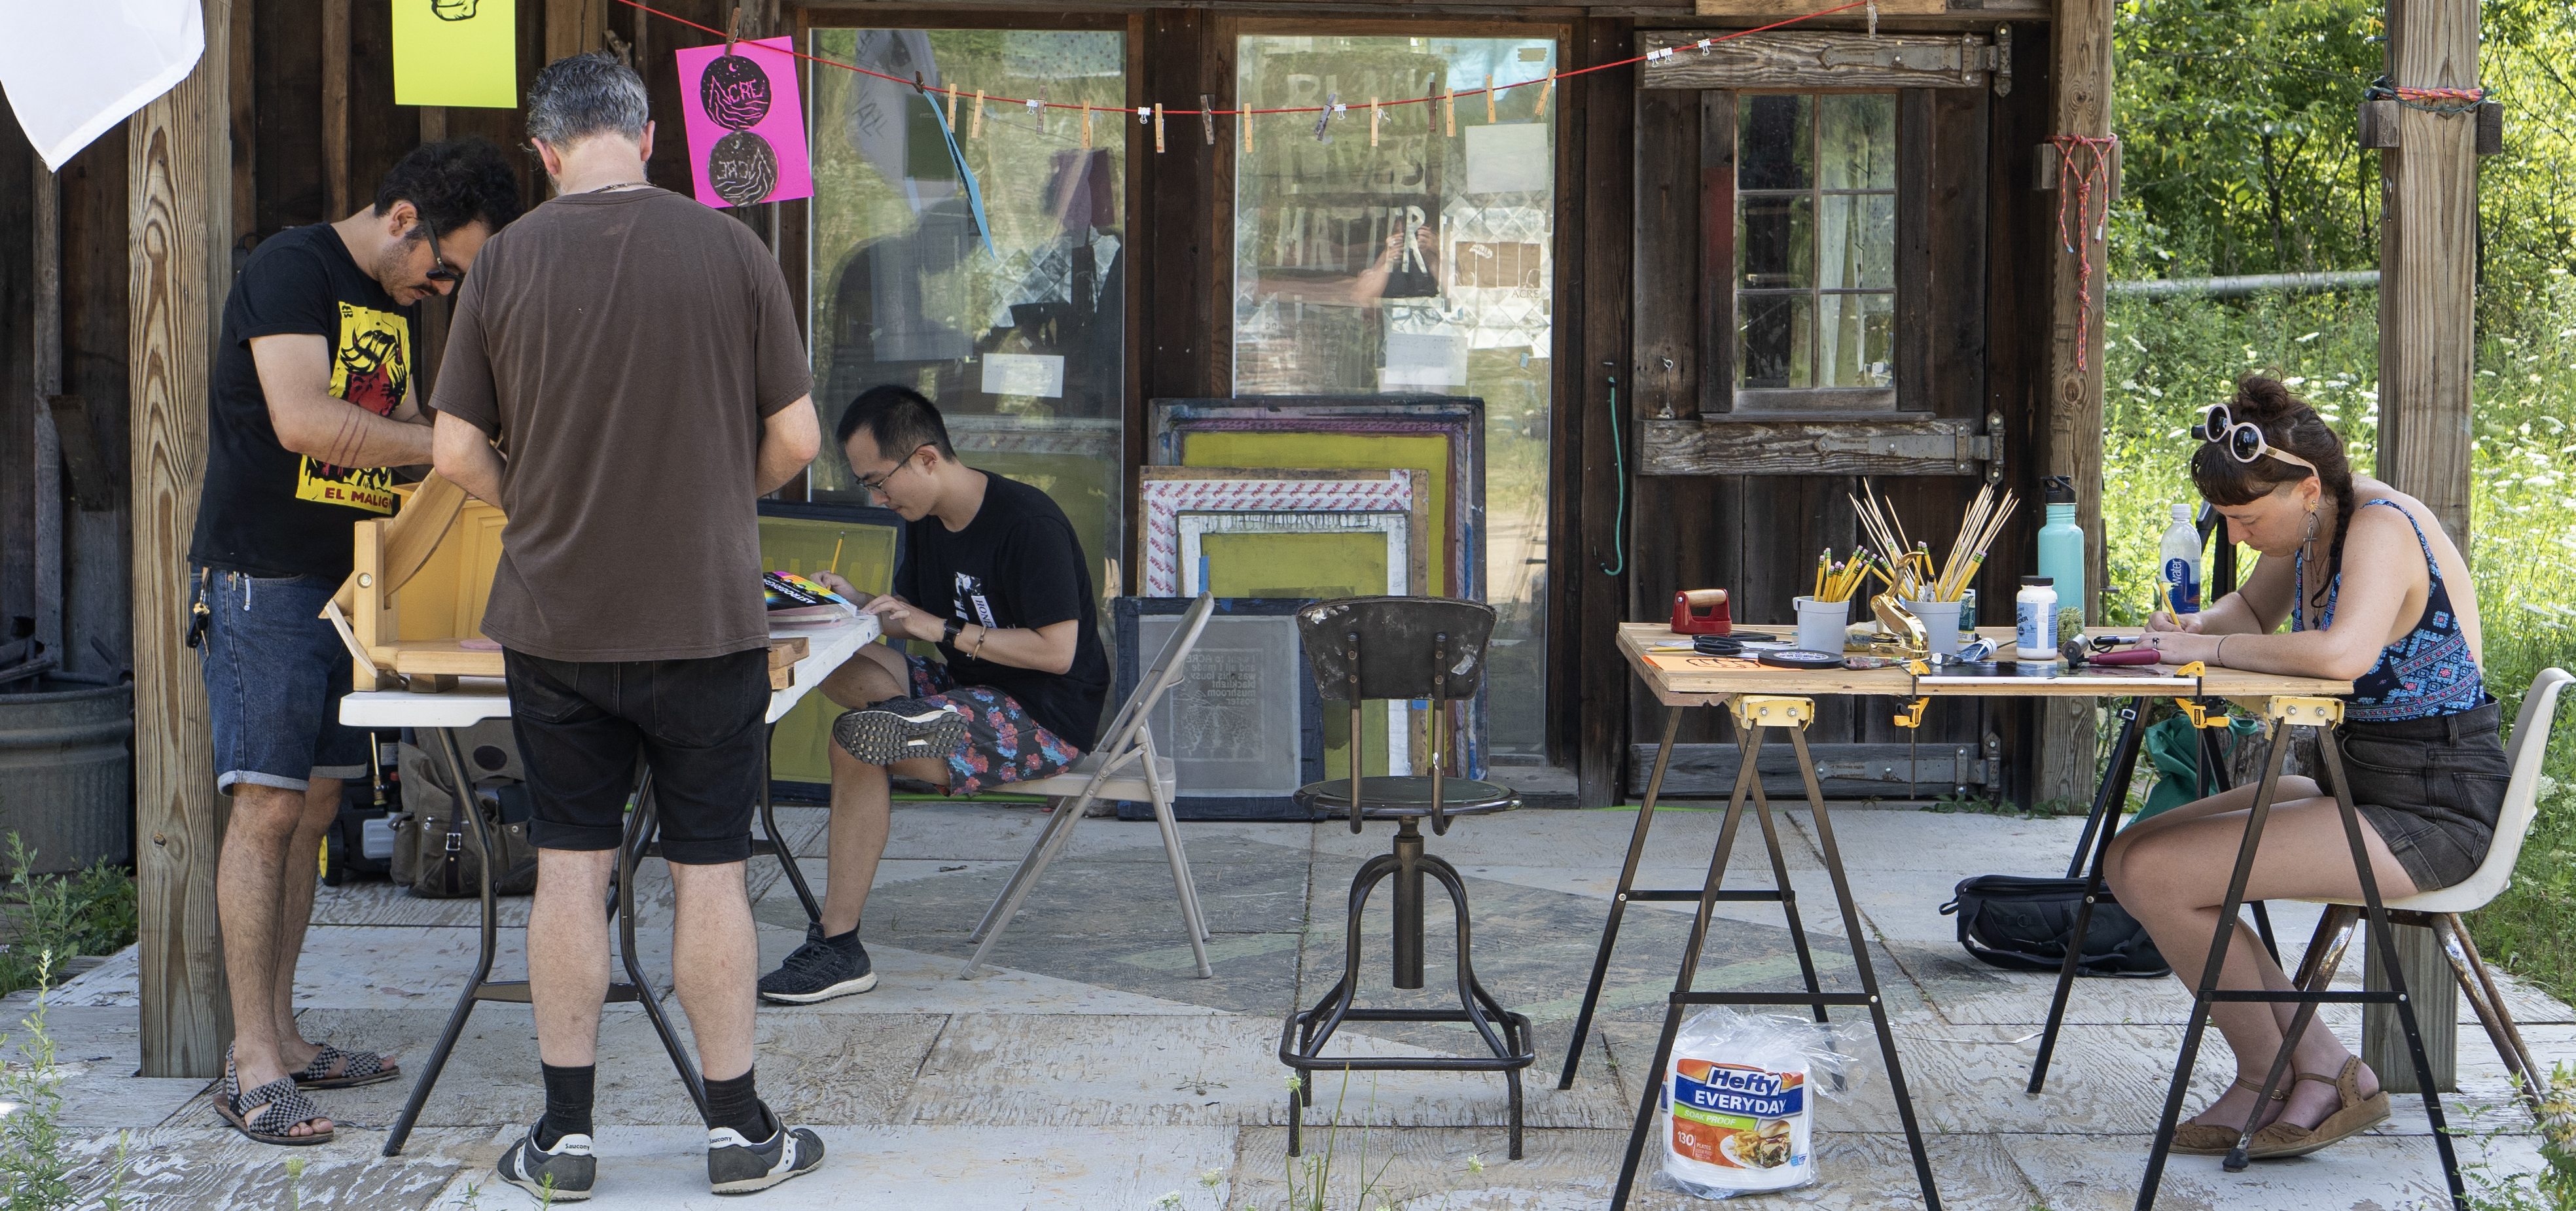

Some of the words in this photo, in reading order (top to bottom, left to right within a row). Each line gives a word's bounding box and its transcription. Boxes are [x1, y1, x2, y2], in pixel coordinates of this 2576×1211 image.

[709, 75, 764, 107] ACRE
[1512, 289, 1540, 298] ACRE
[325, 487, 345, 500] EL
[1710, 1070, 1780, 1097] Hefty
[1695, 1090, 1787, 1114] EVERYDAY
[1685, 1110, 1705, 1121] SOAK
[1706, 1115, 1736, 1126] PROOF
[709, 1136, 732, 1144] Saucony
[1677, 1131, 1694, 1146] 130
